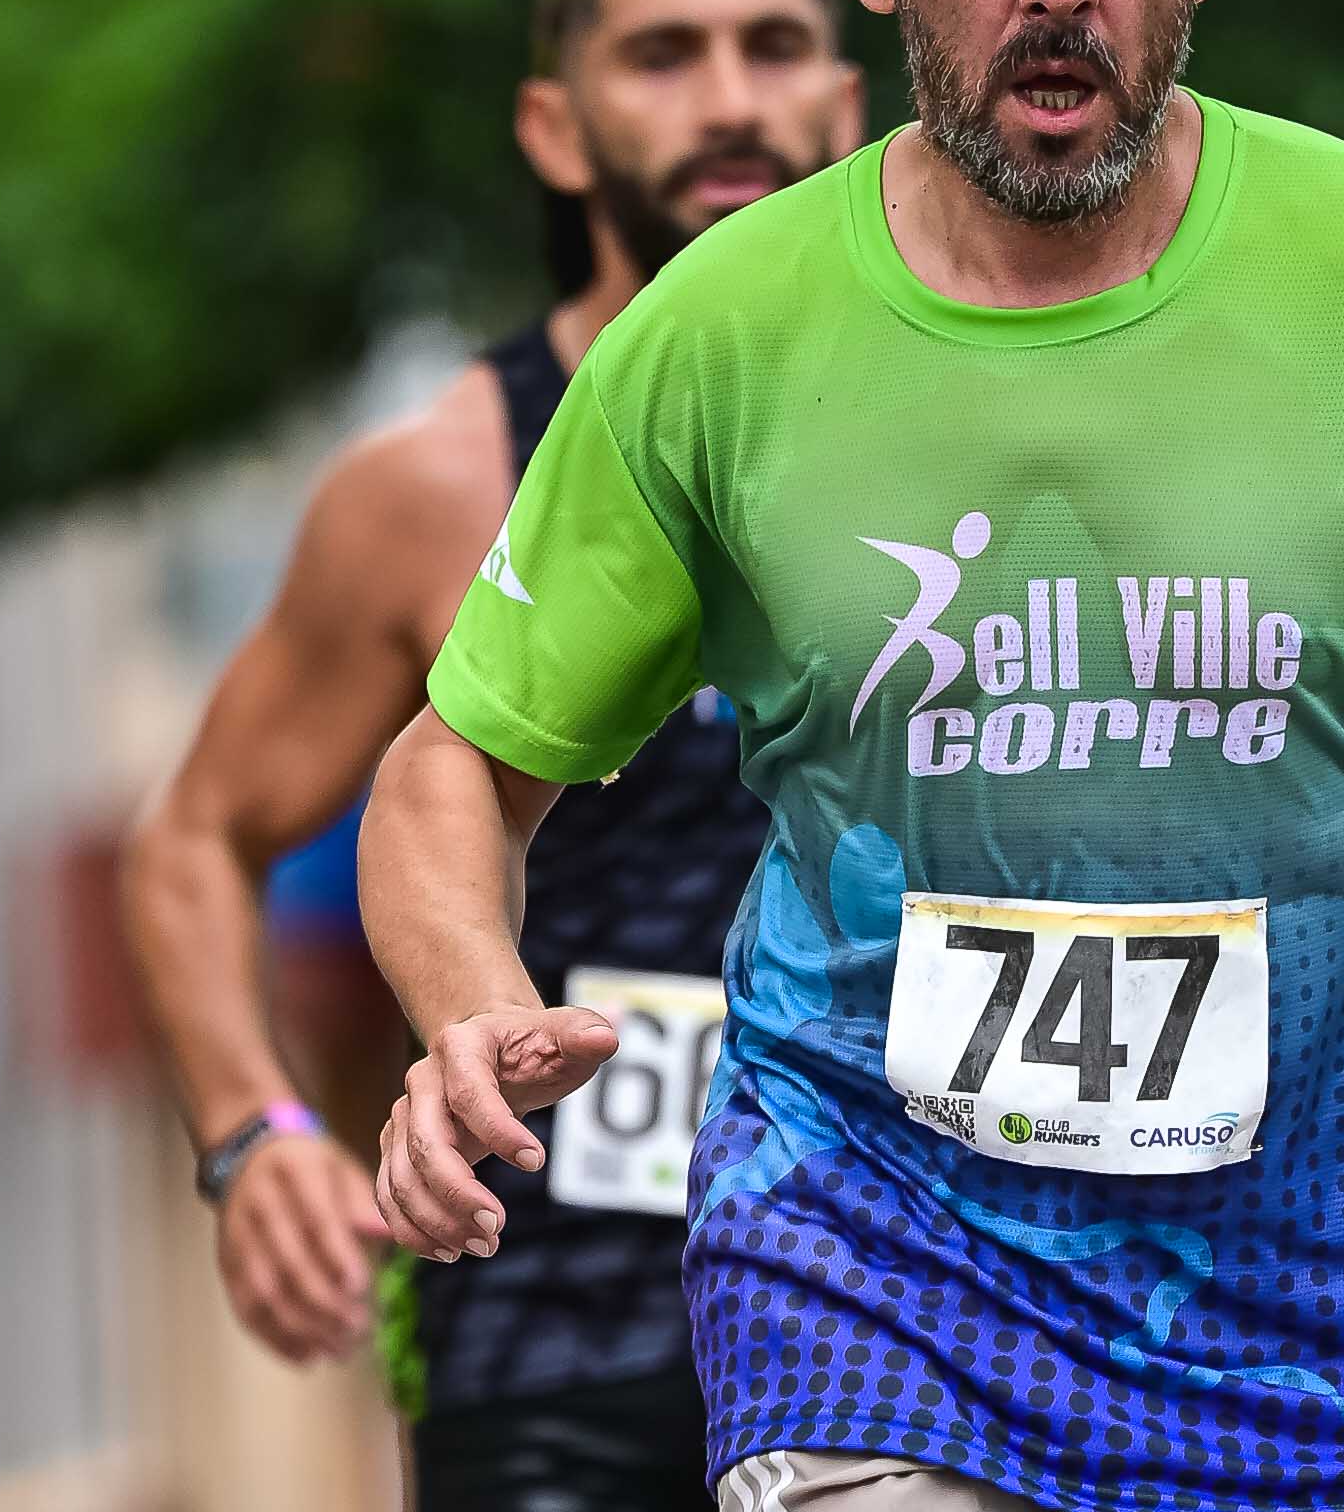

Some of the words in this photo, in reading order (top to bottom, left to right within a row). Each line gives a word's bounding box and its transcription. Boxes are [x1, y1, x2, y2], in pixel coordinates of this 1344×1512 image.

[1116, 576, 1304, 692] Ville
[906, 698, 1293, 778] corre
[945, 924, 1221, 1103] 747
[1033, 1130, 1101, 1147] RUNNER'S
[1034, 1119, 1071, 1132] CLUB
[1130, 1125, 1234, 1148] CARUSO
